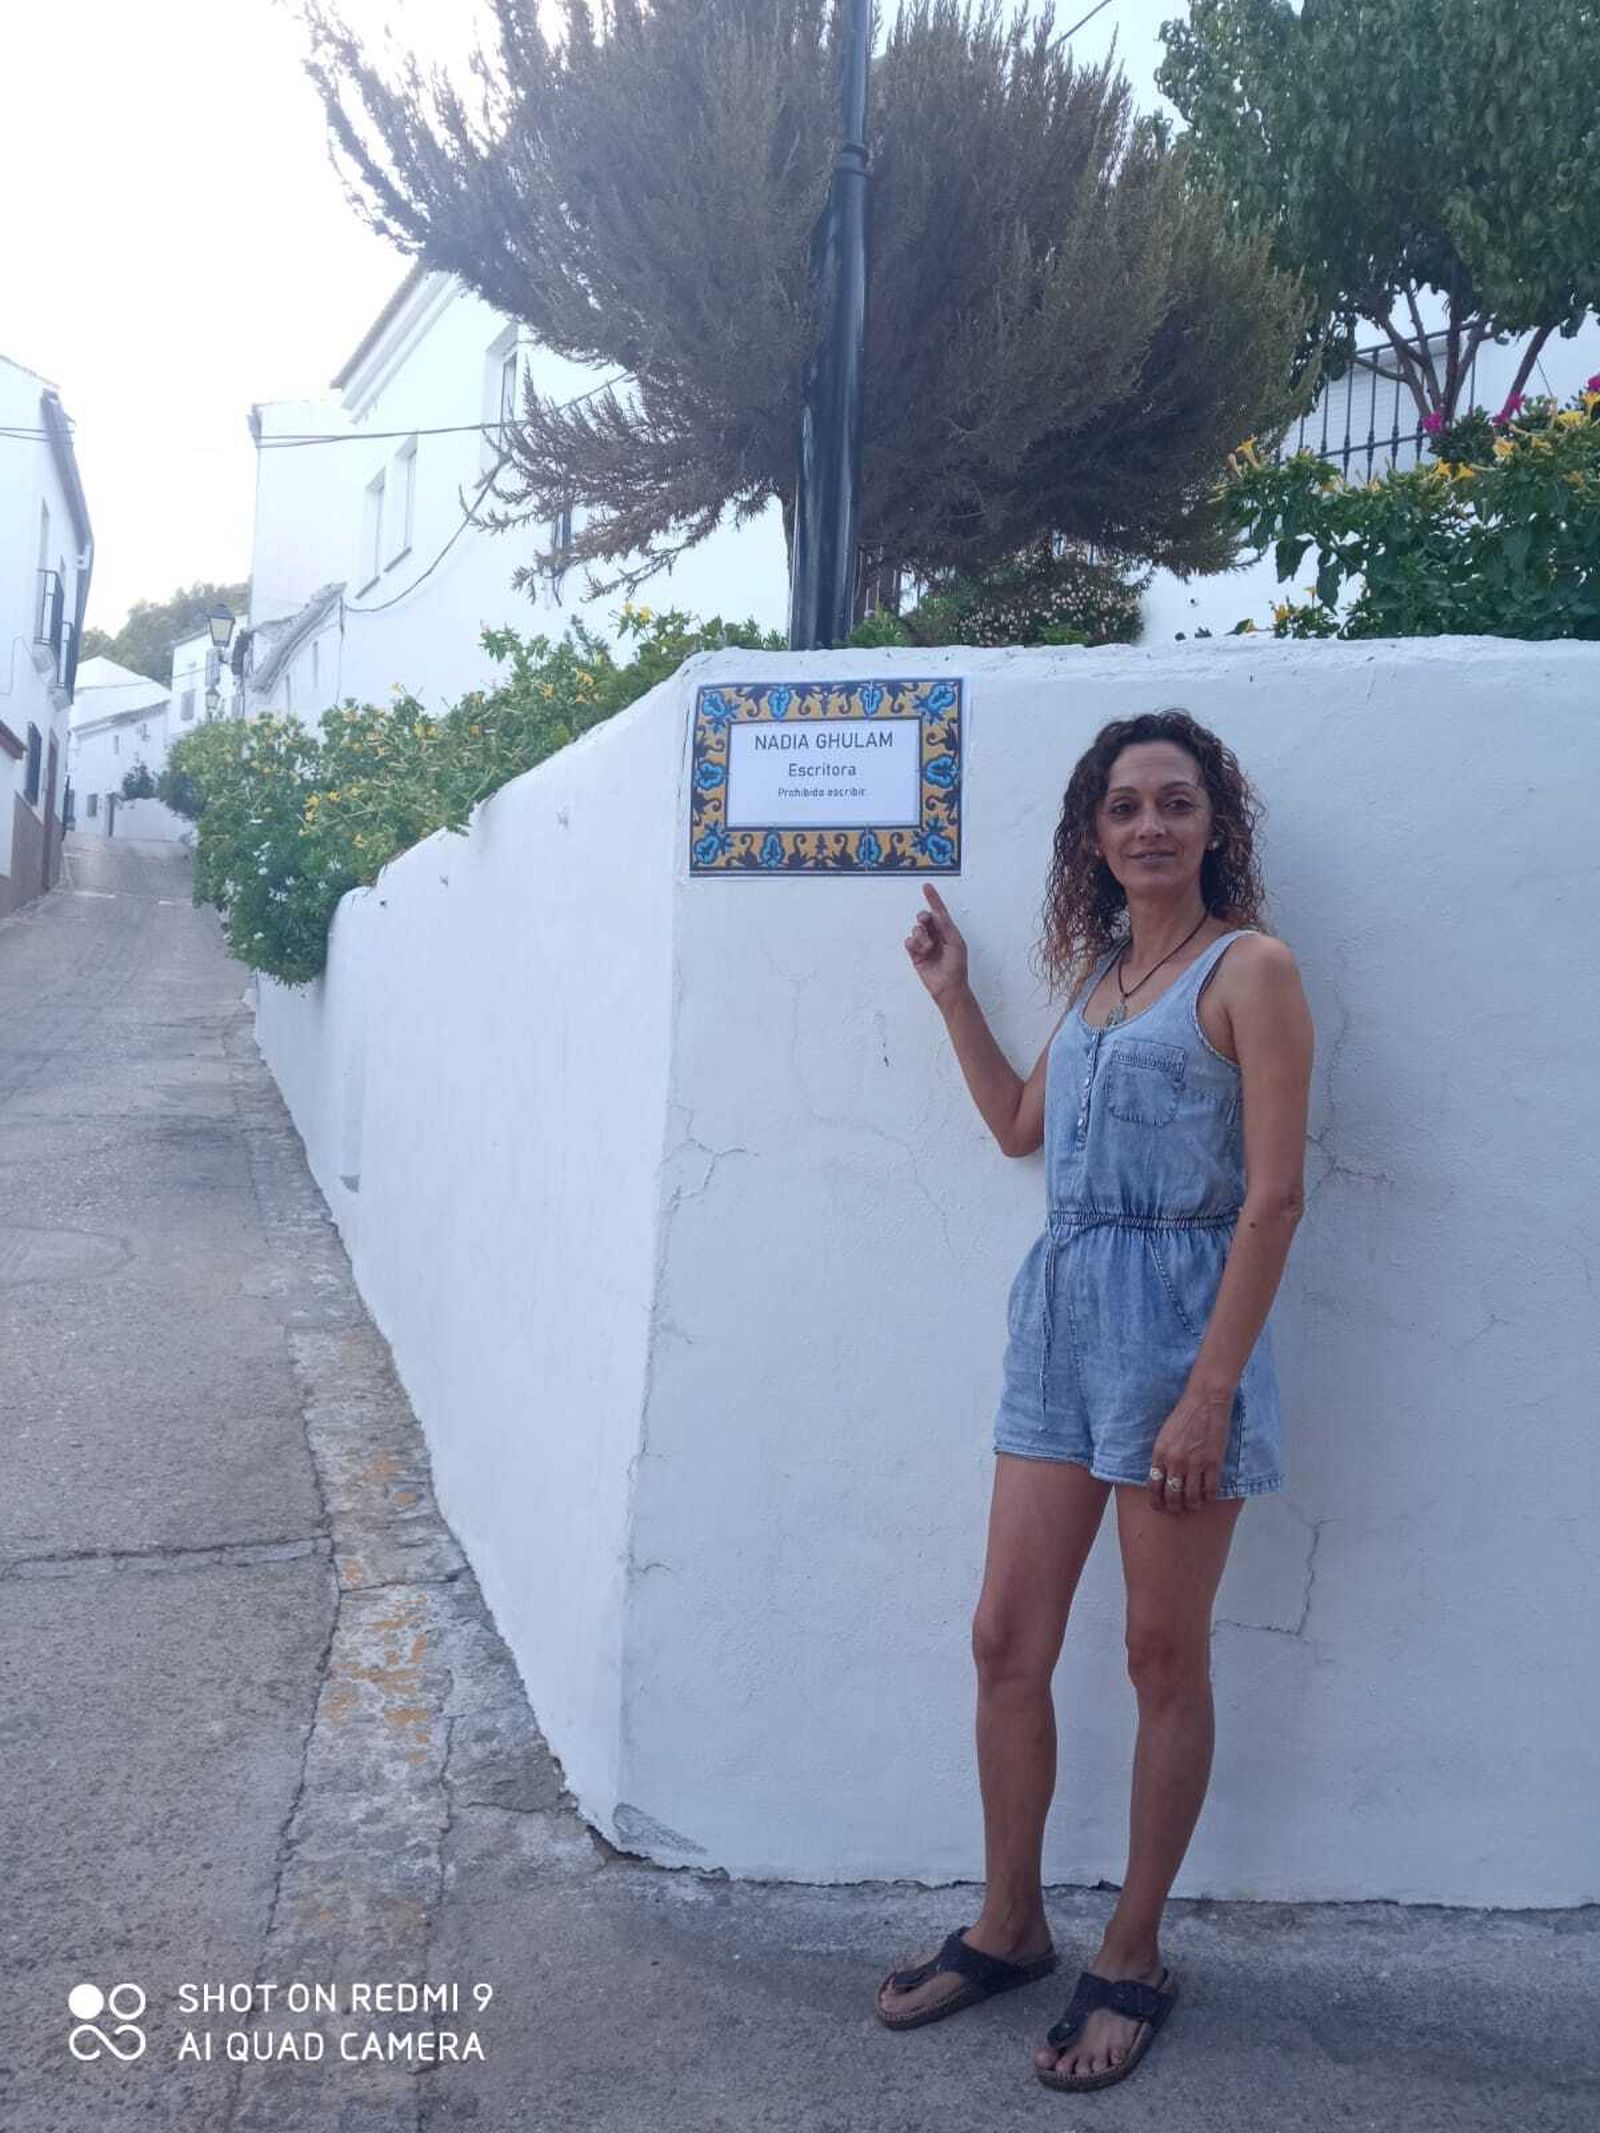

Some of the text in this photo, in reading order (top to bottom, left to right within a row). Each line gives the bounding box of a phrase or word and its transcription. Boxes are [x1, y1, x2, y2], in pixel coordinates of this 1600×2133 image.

[754, 731, 893, 750] NADIA GHULAM
[788, 762, 857, 777] Escritora
[777, 786, 866, 798] Prohibido escribir
